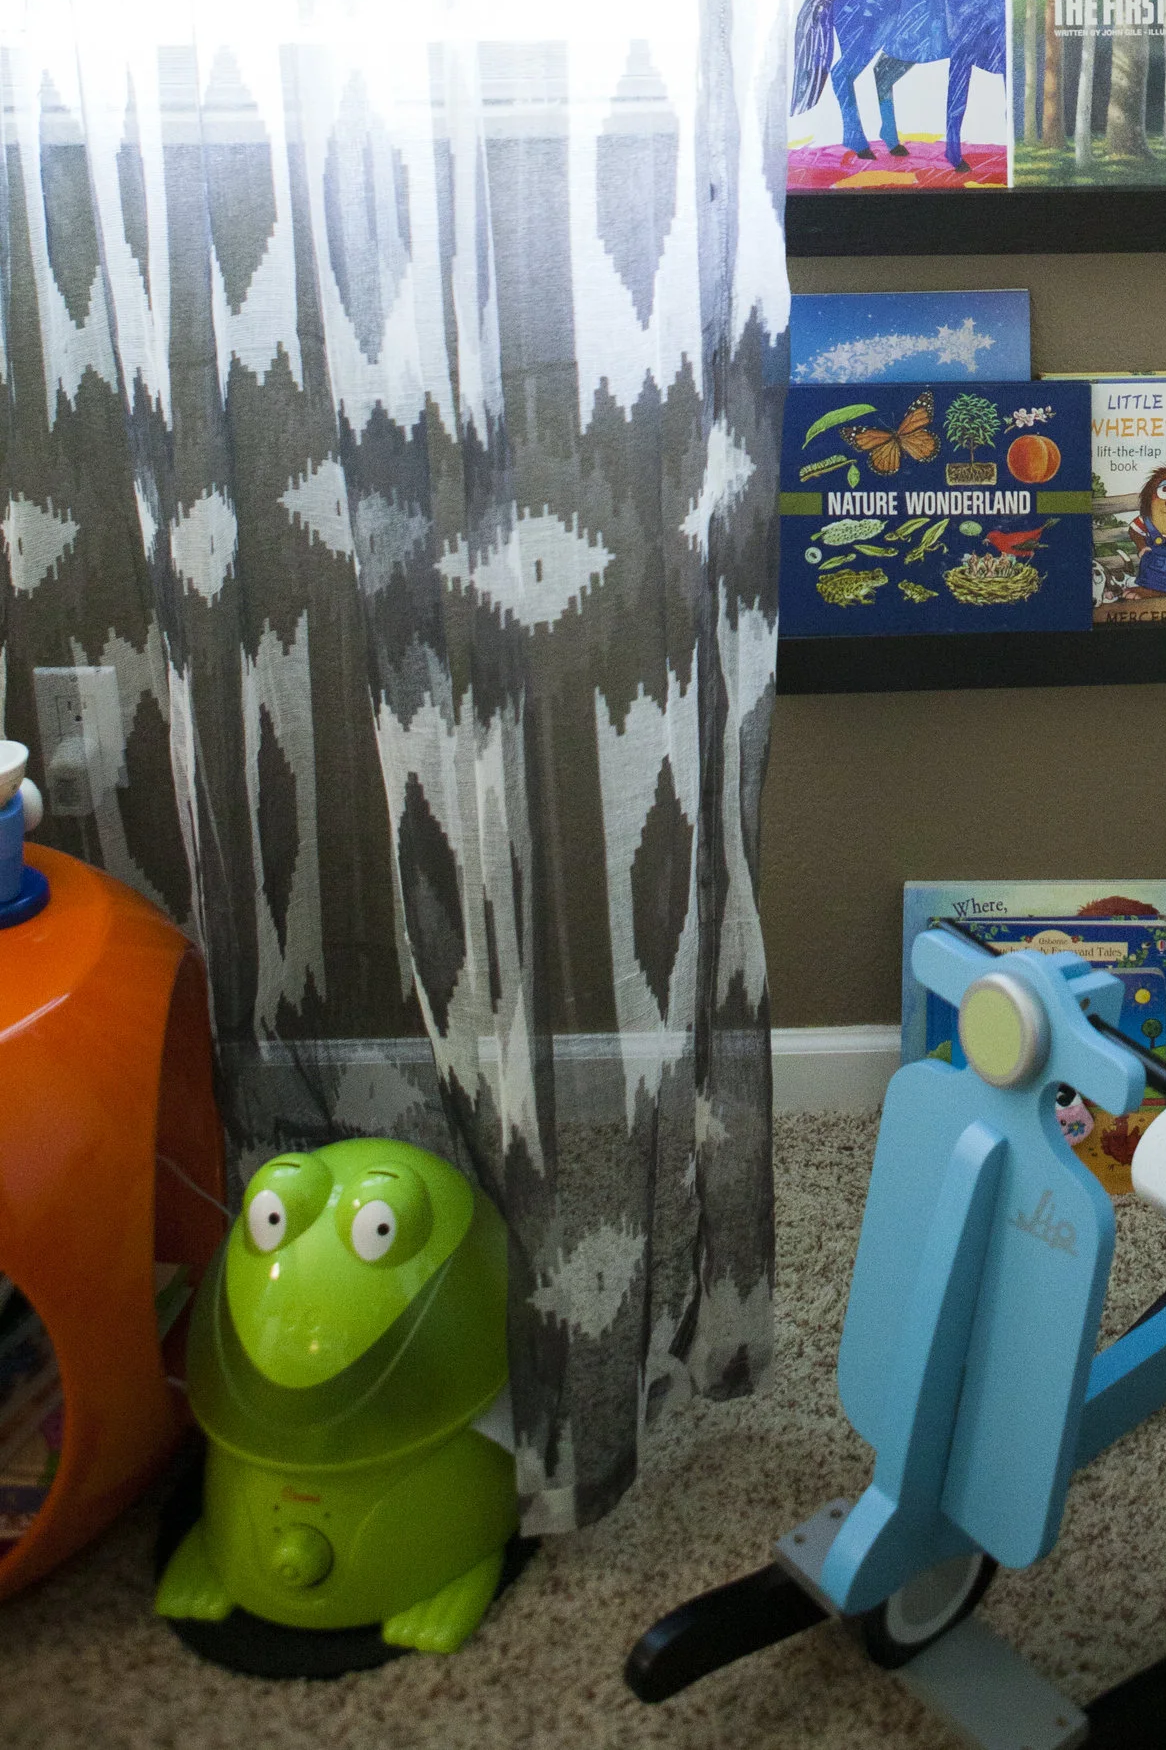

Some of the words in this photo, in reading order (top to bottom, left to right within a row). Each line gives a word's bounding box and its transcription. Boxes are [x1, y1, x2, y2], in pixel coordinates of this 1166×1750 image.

[1054, 29, 1088, 37] WRITTEN
[1090, 29, 1100, 37] BY
[1102, 29, 1123, 37] JOHN
[1107, 394, 1164, 410] LITTLE
[1097, 445, 1162, 458] lift-the-flap
[1110, 459, 1138, 472] book
[828, 491, 898, 517] NATURE
[905, 490, 1032, 516] WONDERLAND
[952, 897, 1008, 918] Where,
[1052, 946, 1094, 957] Faard
[1097, 946, 1122, 957] Tales
